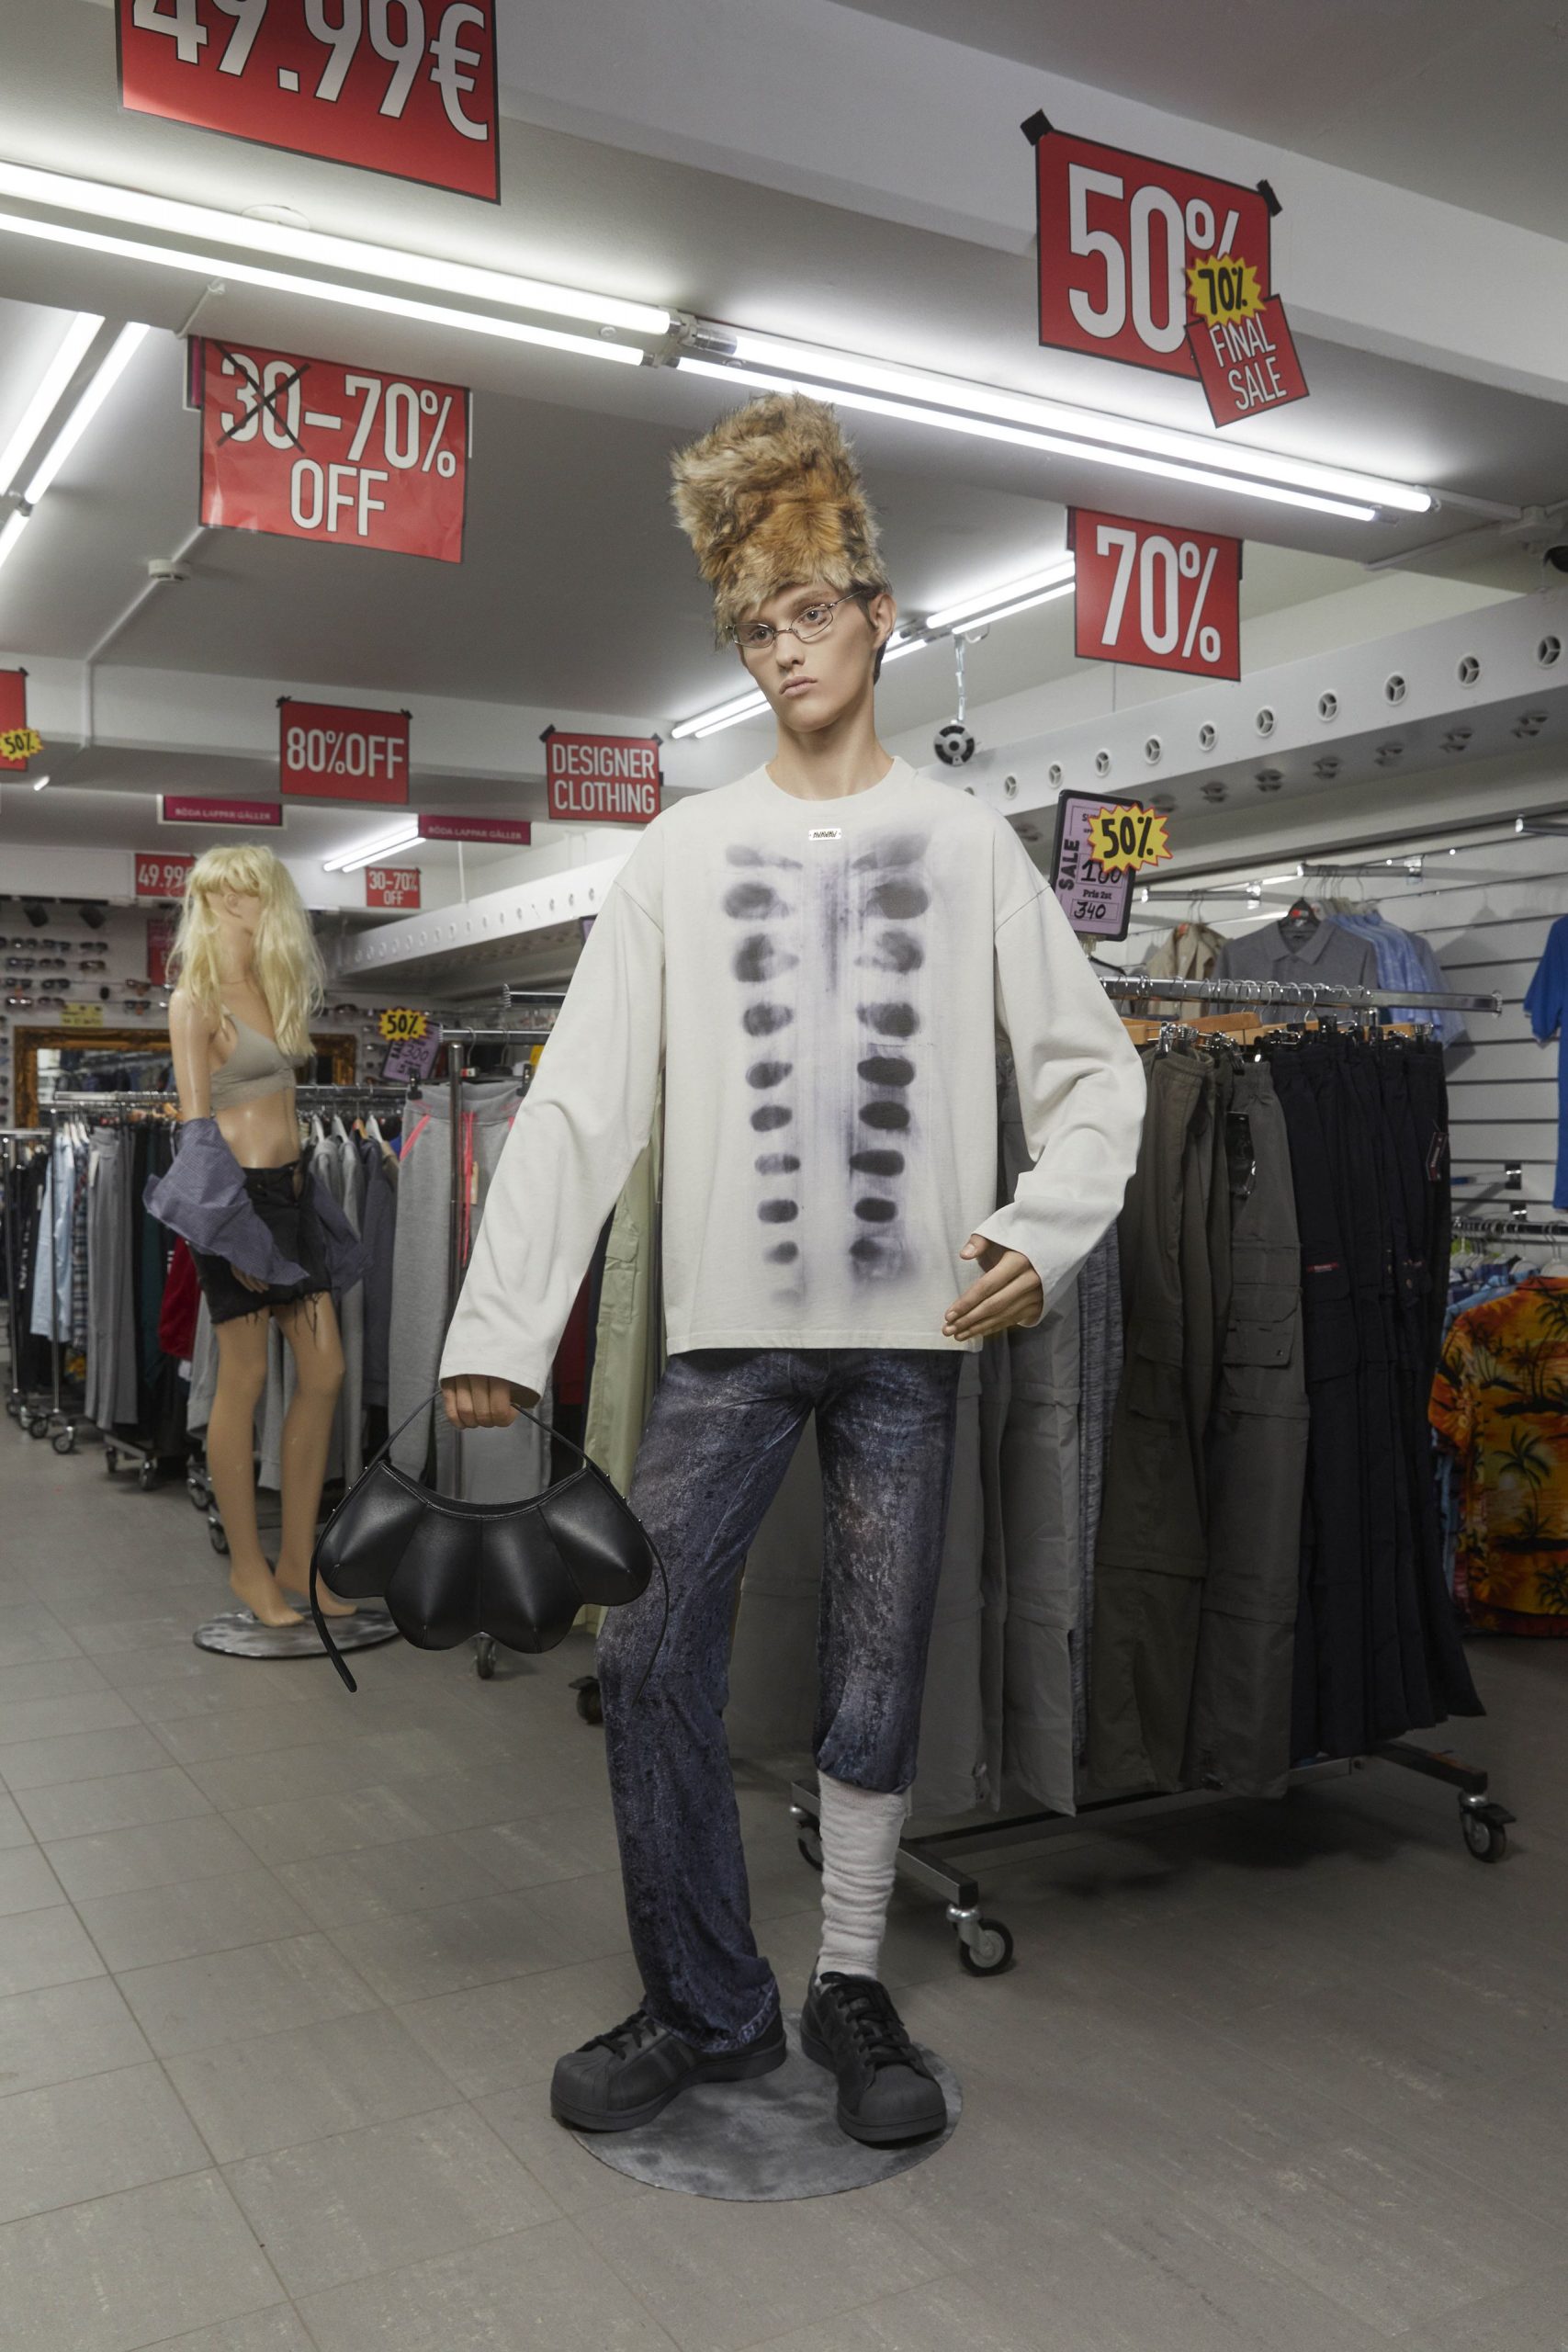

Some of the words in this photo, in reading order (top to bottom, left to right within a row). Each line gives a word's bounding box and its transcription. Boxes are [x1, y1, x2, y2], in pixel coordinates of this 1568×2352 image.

[1198, 266, 1248, 315] 70%
[1209, 312, 1277, 368] FINAL
[1227, 356, 1287, 411] SALE
[290, 458, 389, 537] OFF
[1097, 525, 1221, 663] 70%
[4, 732, 35, 753] 50%
[552, 743, 656, 779] DESIGNER
[554, 779, 656, 815] CLOTHING
[1101, 816, 1154, 858] 50%
[1058, 839, 1080, 890] SALE
[383, 889, 405, 906] OFF
[1074, 901, 1106, 920] 340
[1082, 889, 1100, 899] Pris
[387, 1013, 419, 1035] 50%
